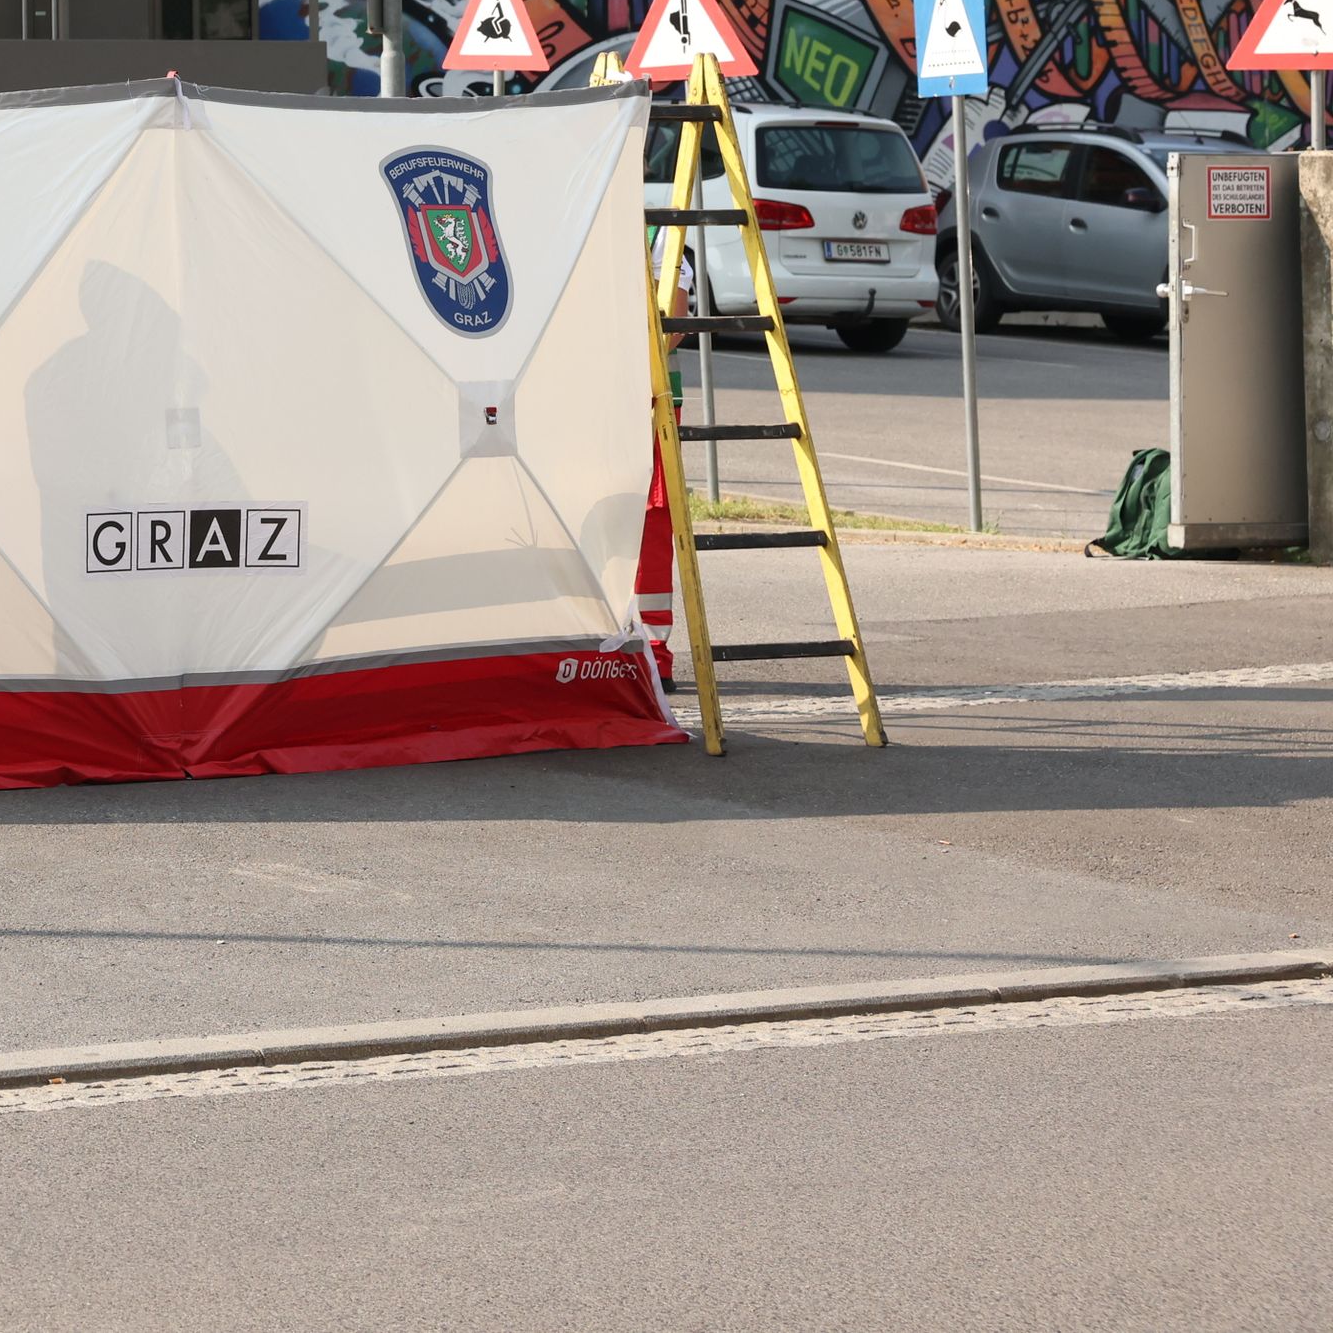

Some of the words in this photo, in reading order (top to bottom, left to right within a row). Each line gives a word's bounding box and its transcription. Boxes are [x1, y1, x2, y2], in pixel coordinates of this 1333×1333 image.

[784, 26, 860, 108] NEO
[389, 157, 485, 181] BERUFSFEUERWEHR
[1212, 171, 1265, 182] UNBEFUGTEN
[1213, 184, 1221, 192] IST
[1222, 184, 1234, 192] DAS
[1236, 184, 1265, 192] BETRETEN
[1212, 193, 1222, 201] DES
[1212, 203, 1265, 214] VERBOTEN!
[454, 311, 493, 327] GRAZ
[92, 516, 289, 567] GRAZ
